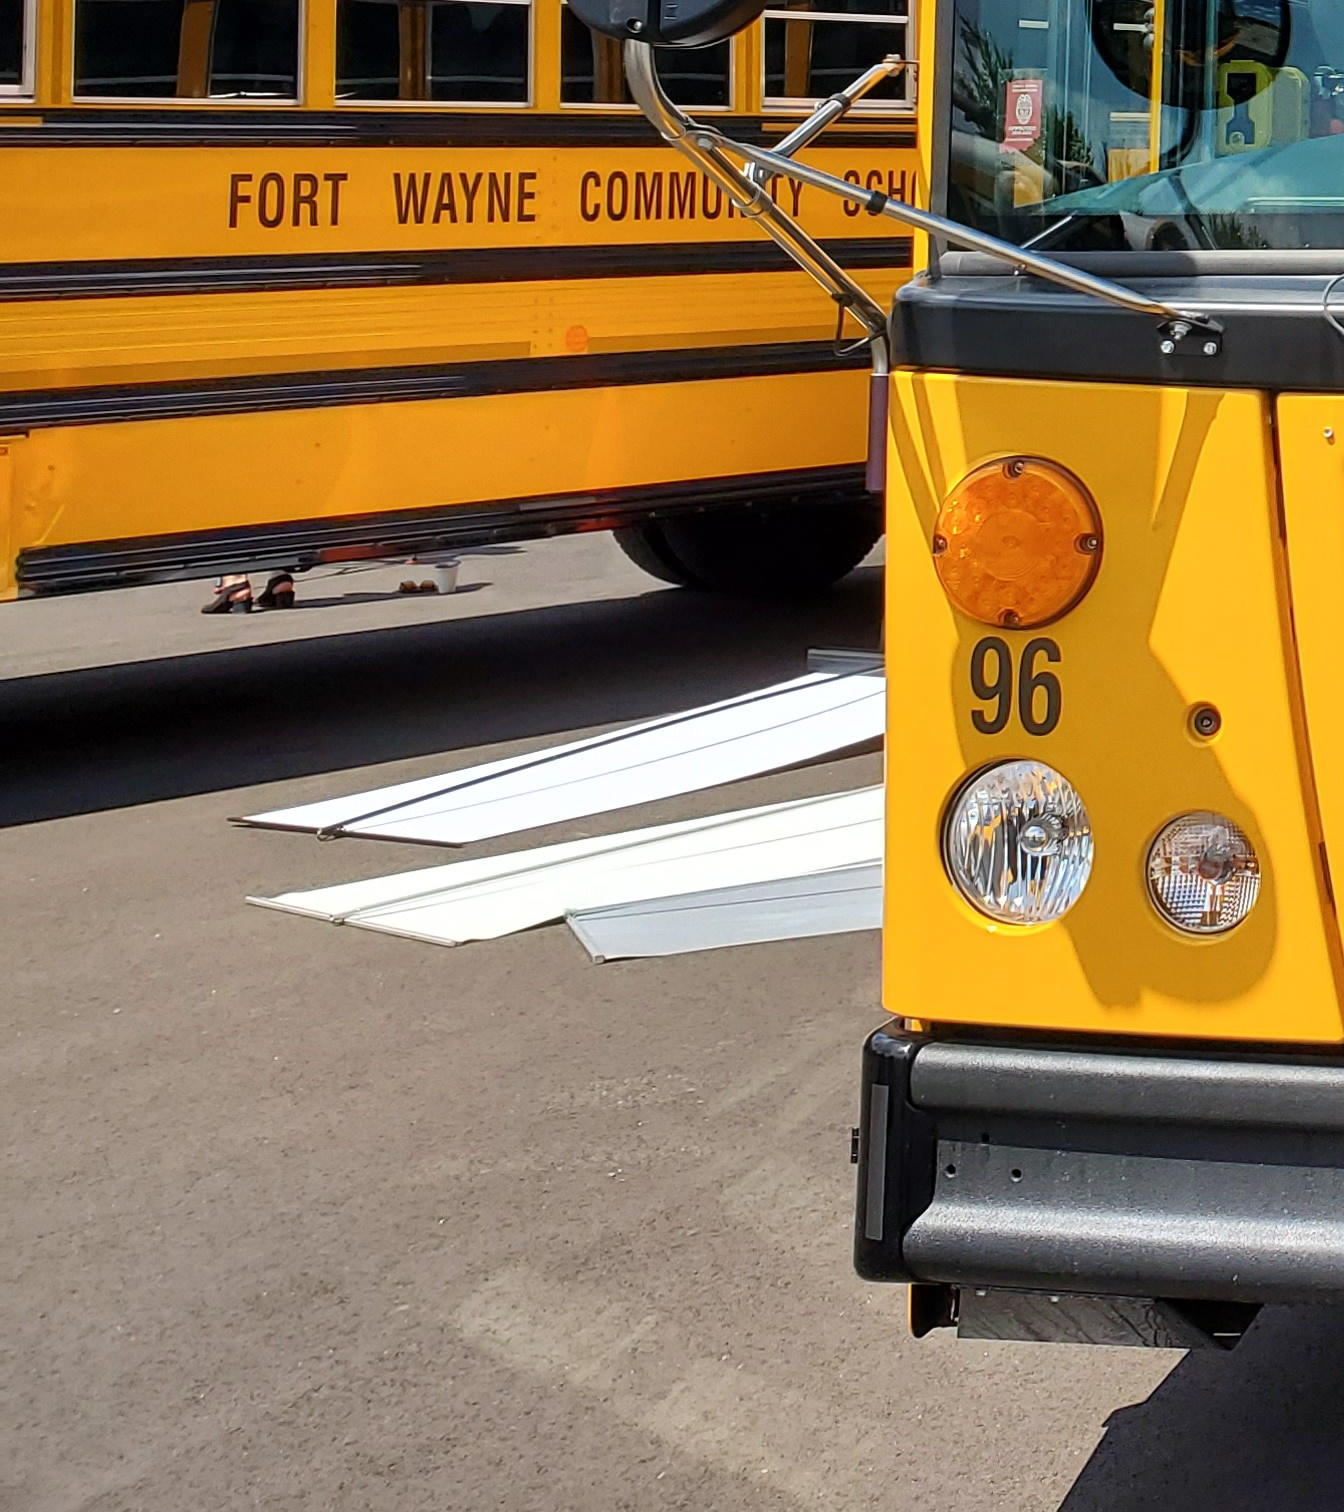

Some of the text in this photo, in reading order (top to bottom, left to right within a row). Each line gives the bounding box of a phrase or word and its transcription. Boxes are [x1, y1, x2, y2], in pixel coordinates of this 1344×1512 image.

[228, 172, 348, 228] FORT
[393, 172, 538, 225] WAYNE
[581, 170, 804, 222] COMMUTY
[970, 637, 1062, 737] 96
